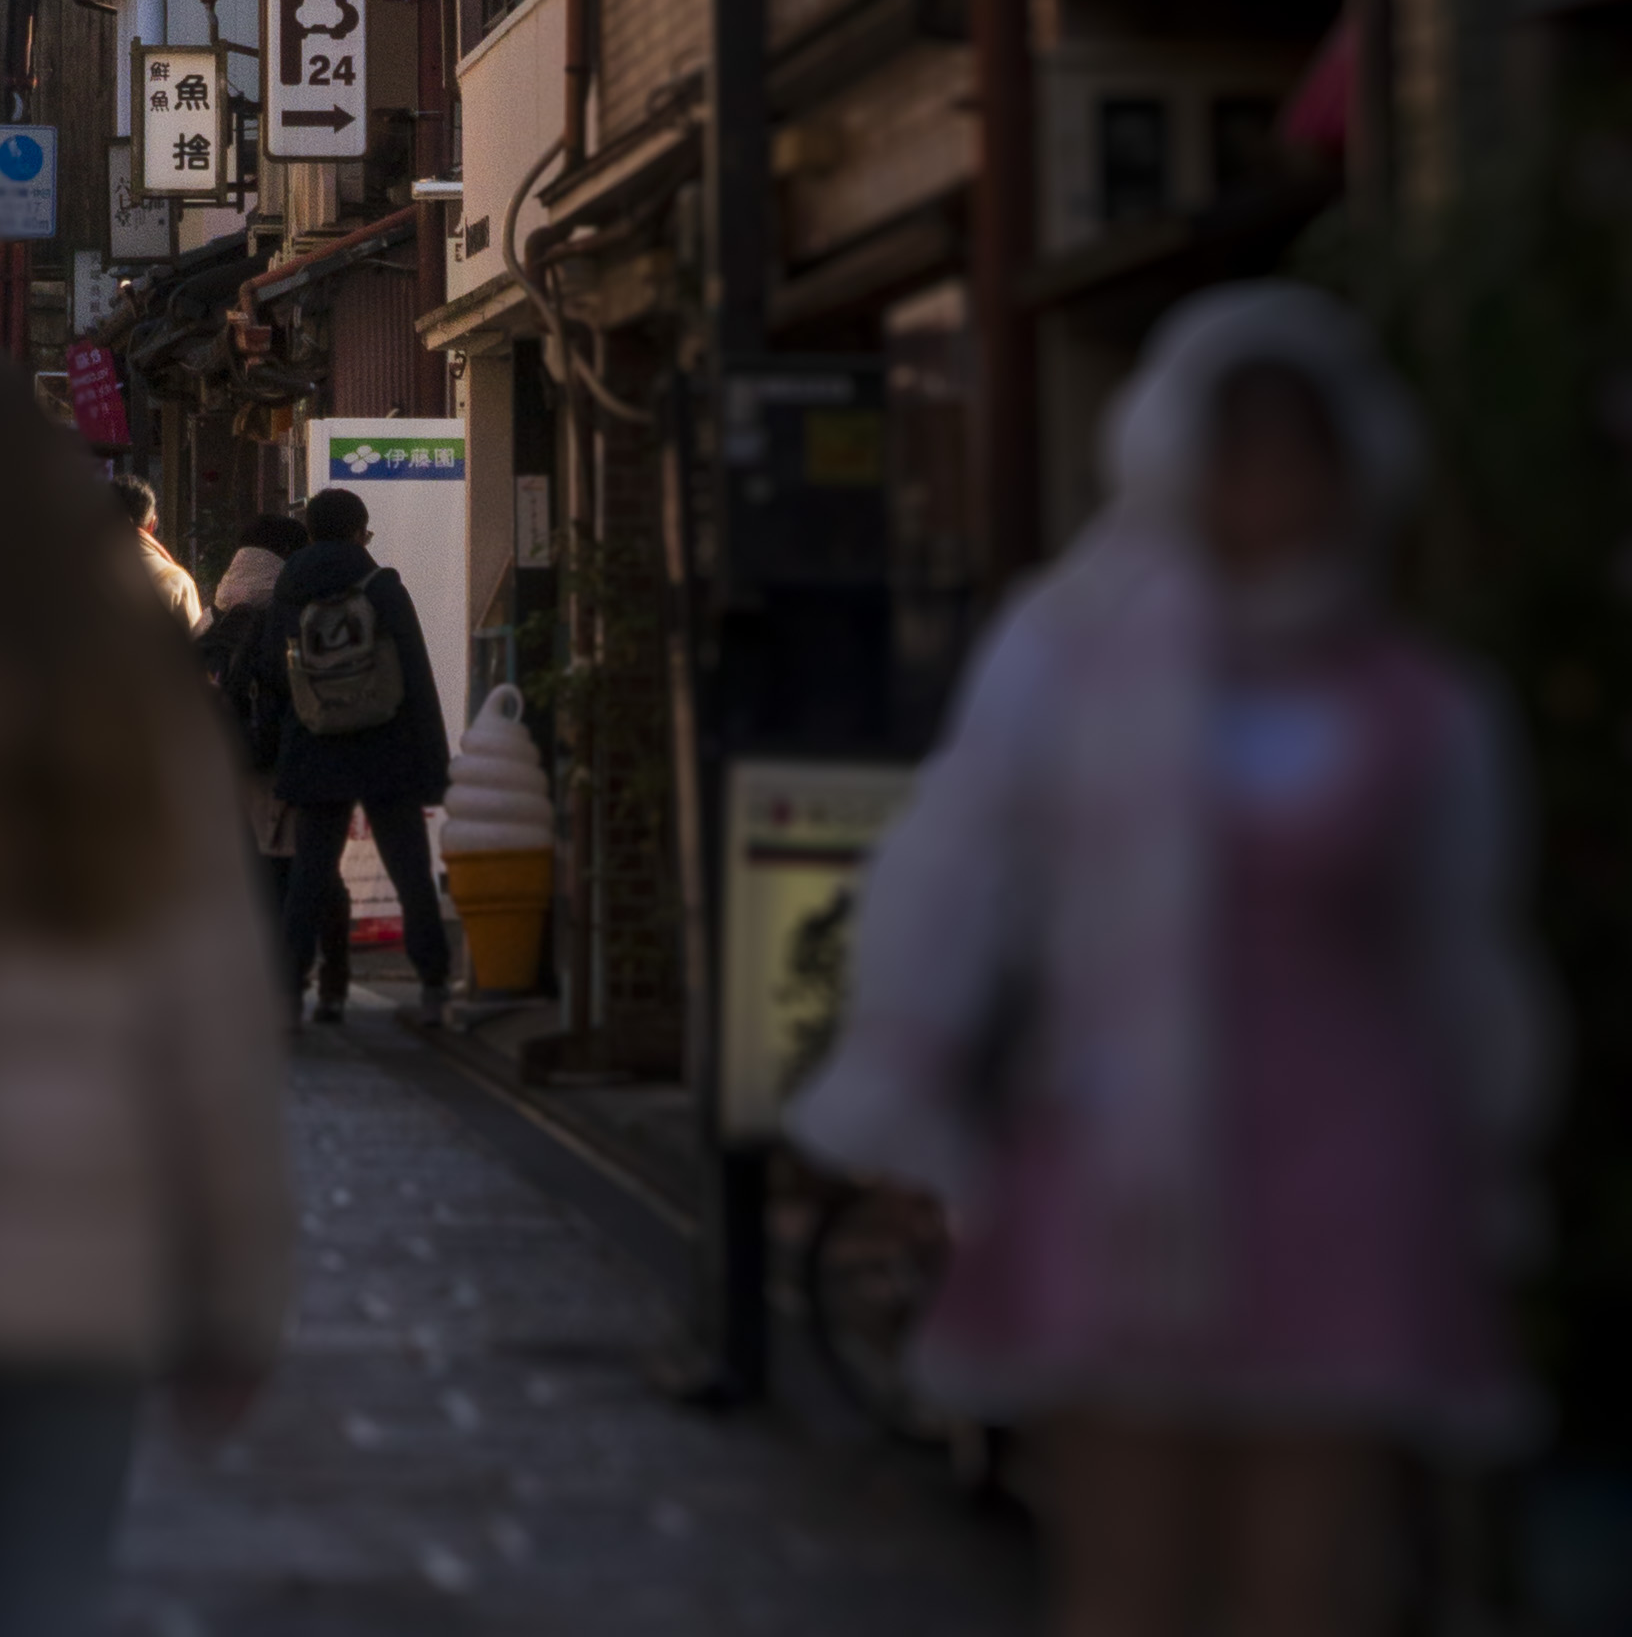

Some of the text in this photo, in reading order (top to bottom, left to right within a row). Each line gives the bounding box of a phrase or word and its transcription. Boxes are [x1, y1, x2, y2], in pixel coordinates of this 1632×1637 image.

[308, 55, 356, 86] 24
[149, 61, 170, 112] 鮮魚
[383, 447, 455, 469] 伊藤園
